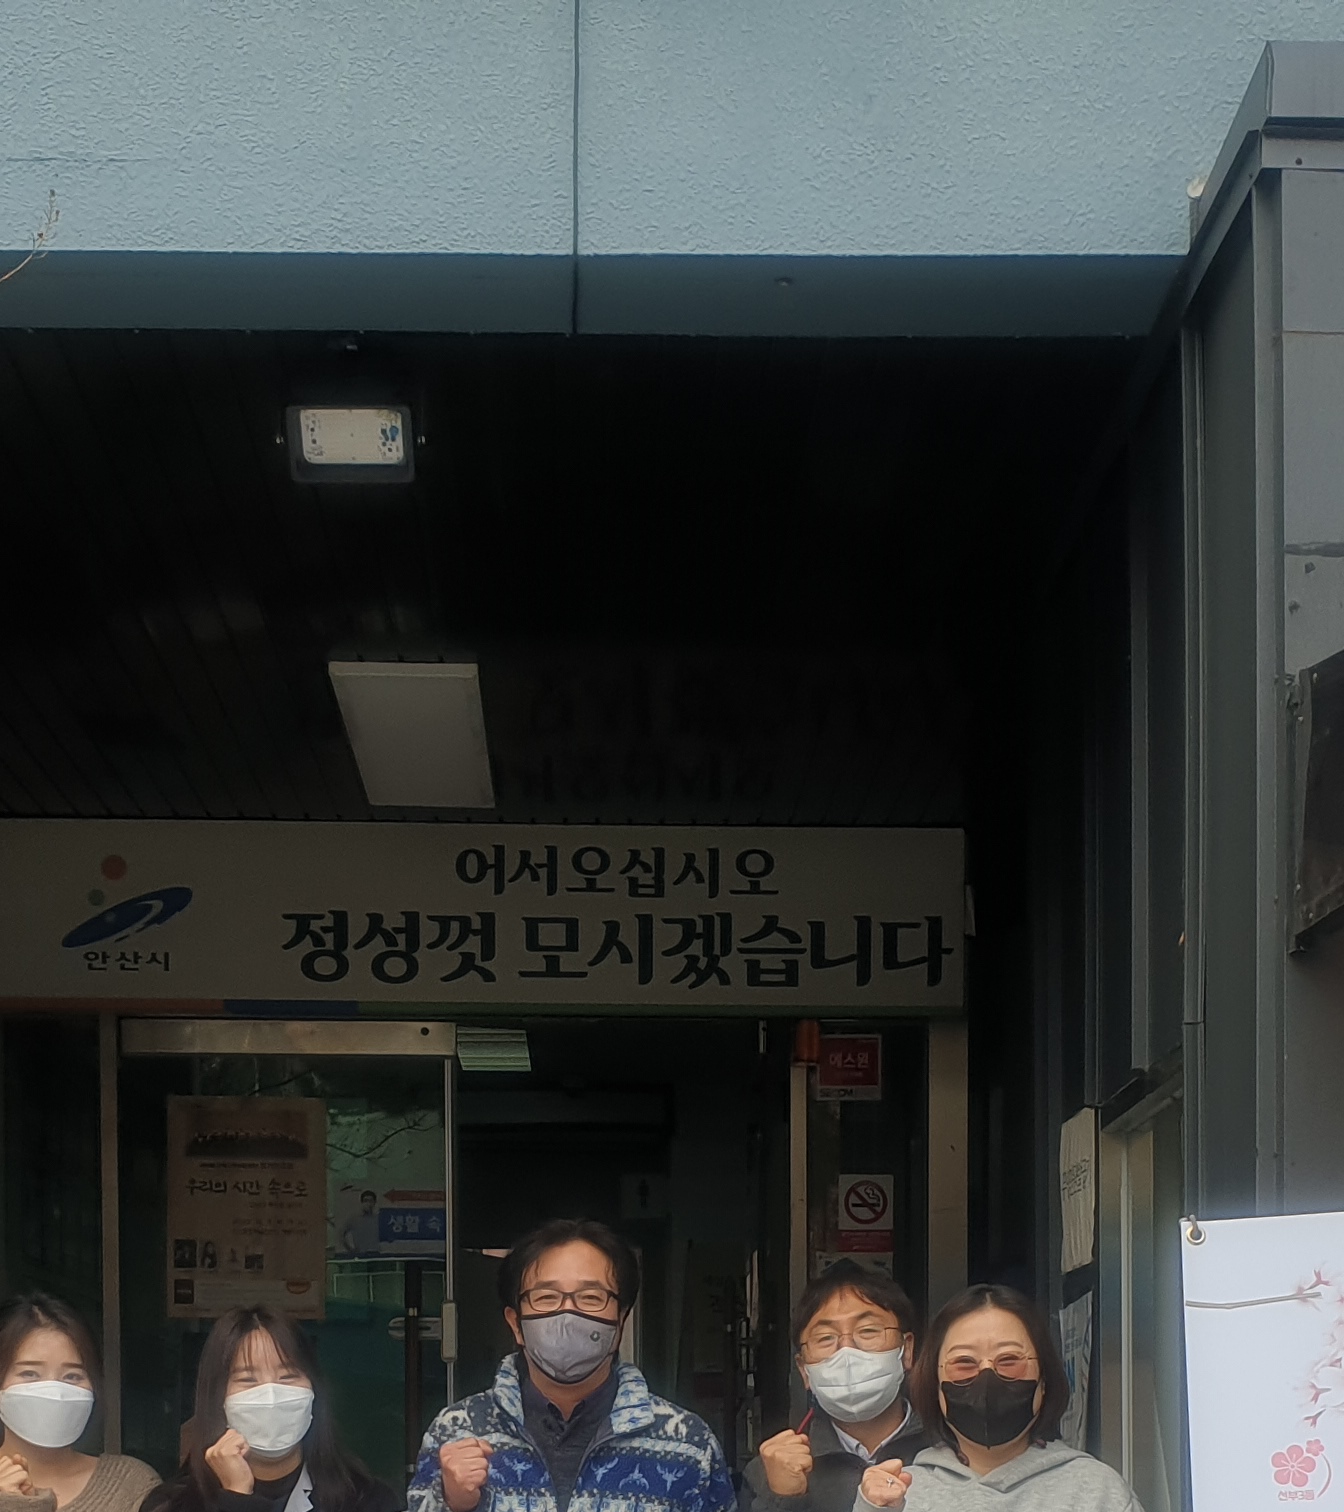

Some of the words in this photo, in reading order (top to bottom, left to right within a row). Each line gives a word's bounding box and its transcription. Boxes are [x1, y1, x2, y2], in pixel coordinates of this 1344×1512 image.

[454, 843, 779, 900] 어서오십시오
[280, 908, 498, 985] 정성껏
[519, 910, 953, 989] 모시겠습니다
[82, 949, 171, 974] 안산시
[828, 1051, 870, 1070] 에스원
[185, 1178, 227, 1195] 우리의
[233, 1179, 261, 1195] 시간
[268, 1178, 309, 1198] 속으로
[387, 1213, 421, 1233] 생활
[1277, 1489, 1315, 1501] 선부3동
